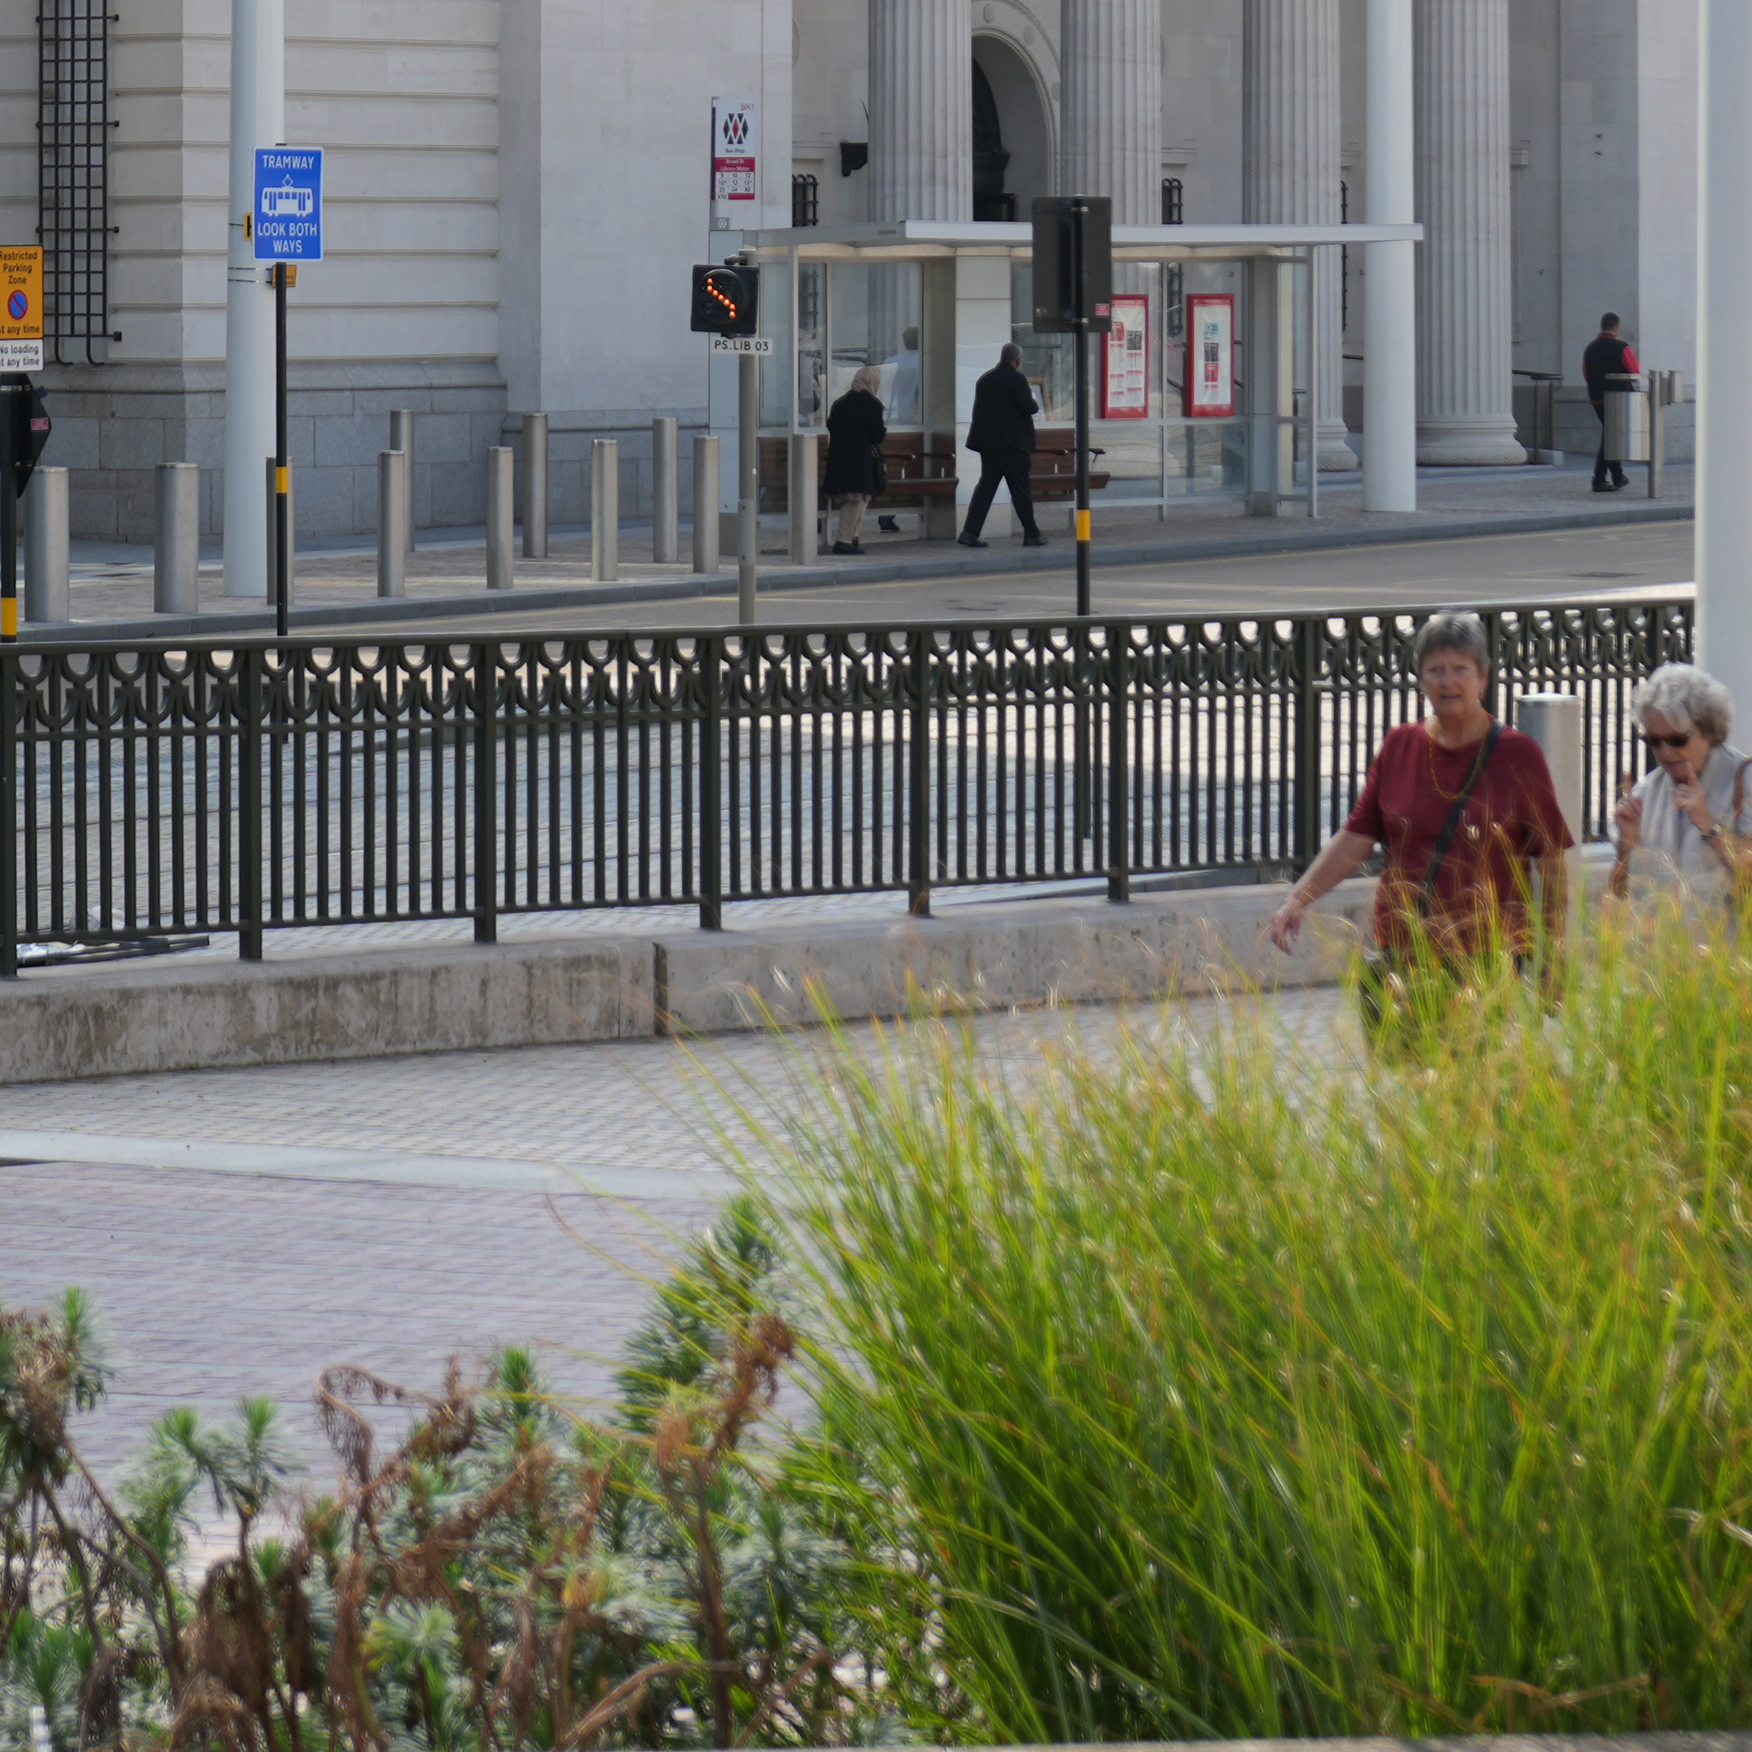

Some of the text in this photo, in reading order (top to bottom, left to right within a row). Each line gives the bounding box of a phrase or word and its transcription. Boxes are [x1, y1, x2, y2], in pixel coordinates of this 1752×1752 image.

[262, 154, 315, 169] TRAMWAY
[257, 222, 318, 237] LOOK BOTH
[273, 239, 303, 253] WAYS
[3, 262, 33, 274] Parking
[8, 274, 27, 284] Zone
[7, 327, 21, 336] any
[23, 324, 41, 334] time
[10, 344, 39, 355] loading
[714, 339, 769, 351] PS.LIB 03
[6, 360, 21, 368] any
[22, 357, 40, 366] time
